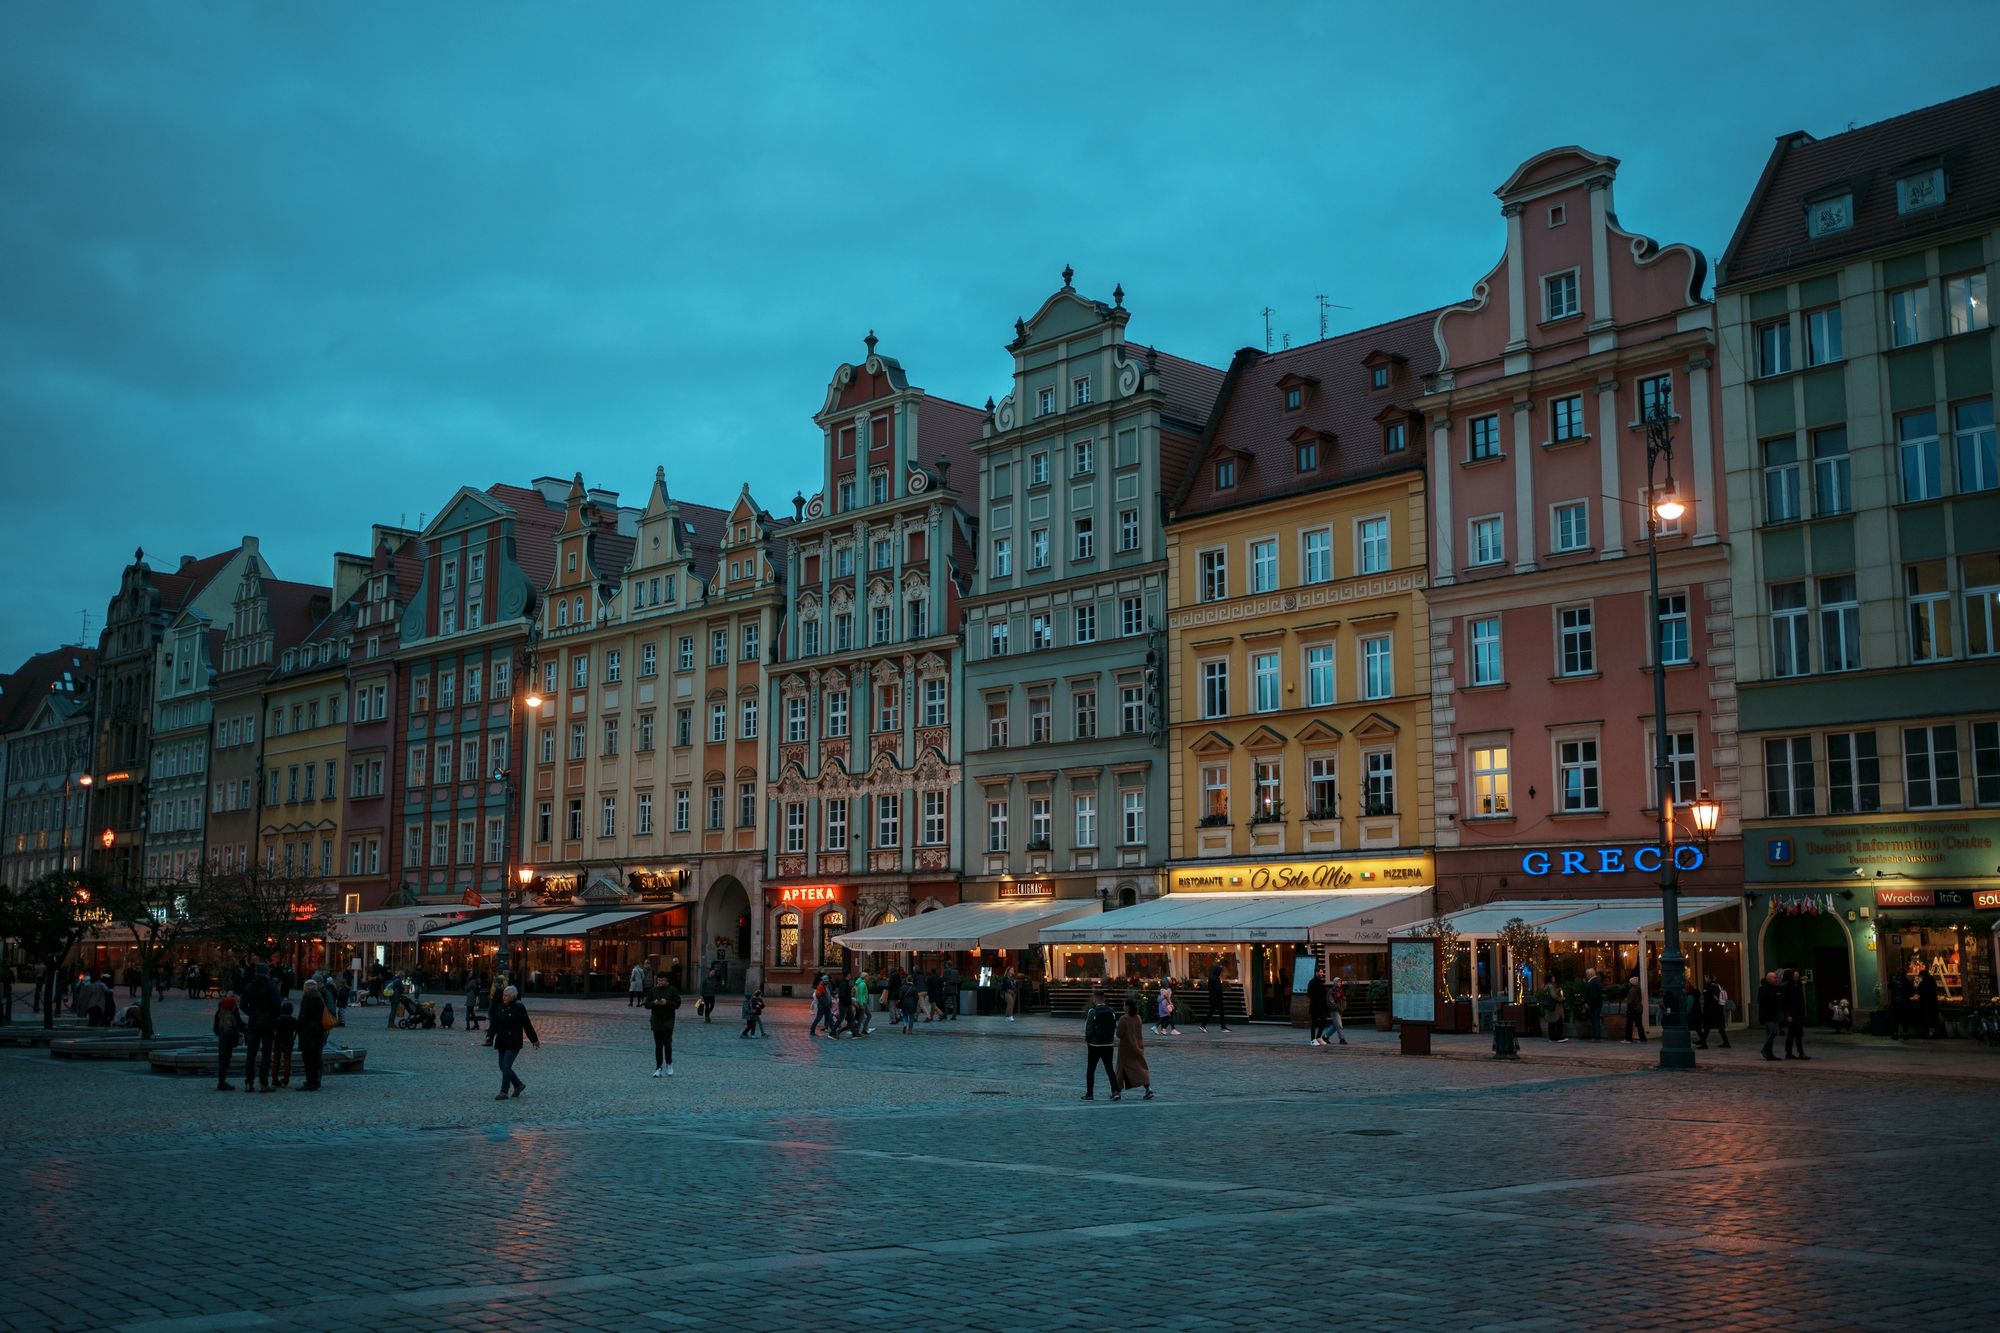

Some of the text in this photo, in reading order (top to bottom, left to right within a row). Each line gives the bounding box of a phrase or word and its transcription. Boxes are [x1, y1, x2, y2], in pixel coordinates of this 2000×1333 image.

[1856, 837, 1940, 852] Information
[1521, 844, 1705, 876] GRECO
[1272, 867, 1309, 890] Sole
[1312, 864, 1353, 888] Mio
[1383, 867, 1422, 879] PIZZERIA
[1178, 876, 1223, 887] RISTORANTE
[783, 887, 835, 901] APTEKA
[1881, 891, 1930, 904] Wrocław
